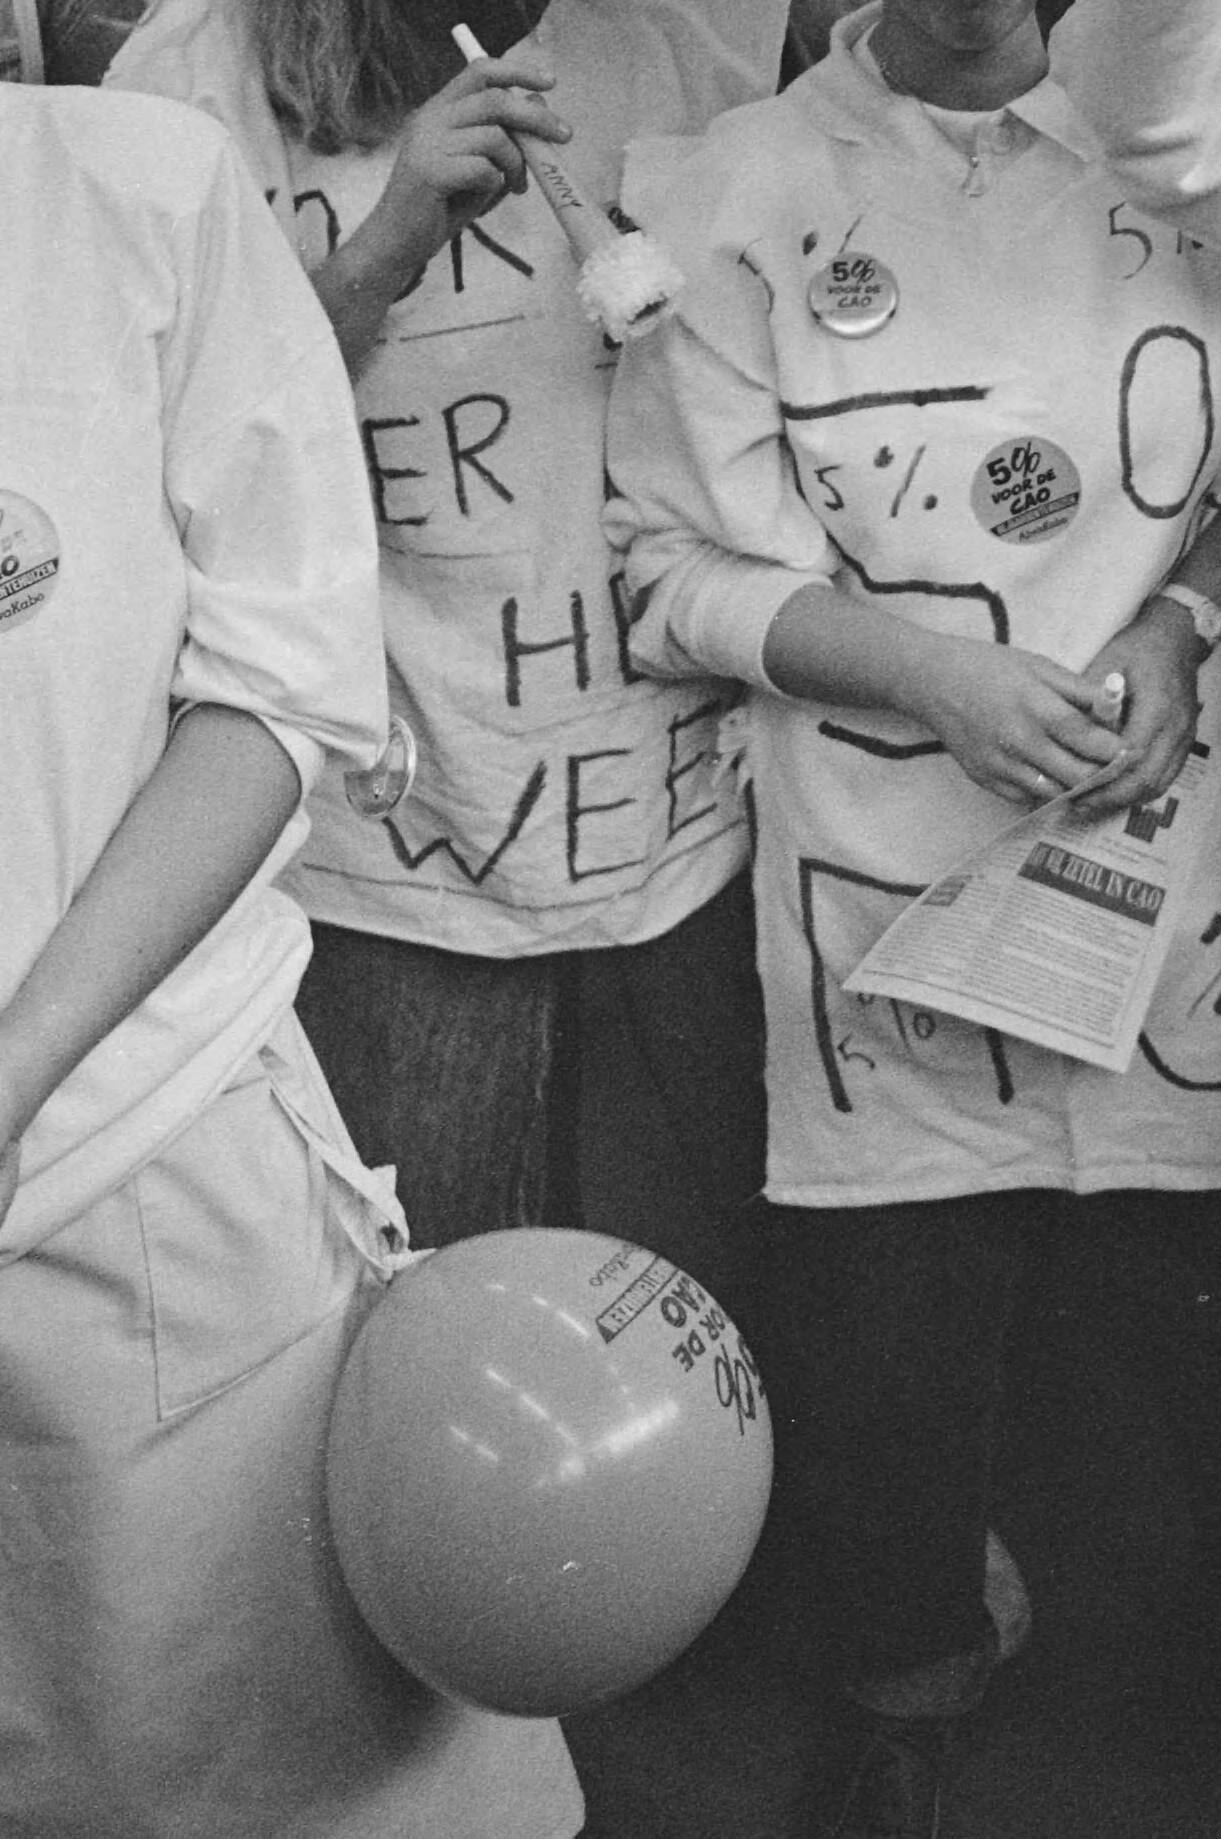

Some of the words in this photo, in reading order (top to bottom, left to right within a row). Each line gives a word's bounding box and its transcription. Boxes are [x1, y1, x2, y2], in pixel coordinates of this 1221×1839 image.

[986, 441, 1043, 486] 5%
[991, 478, 1034, 505] VOOR
[1009, 486, 1051, 515] CAO
